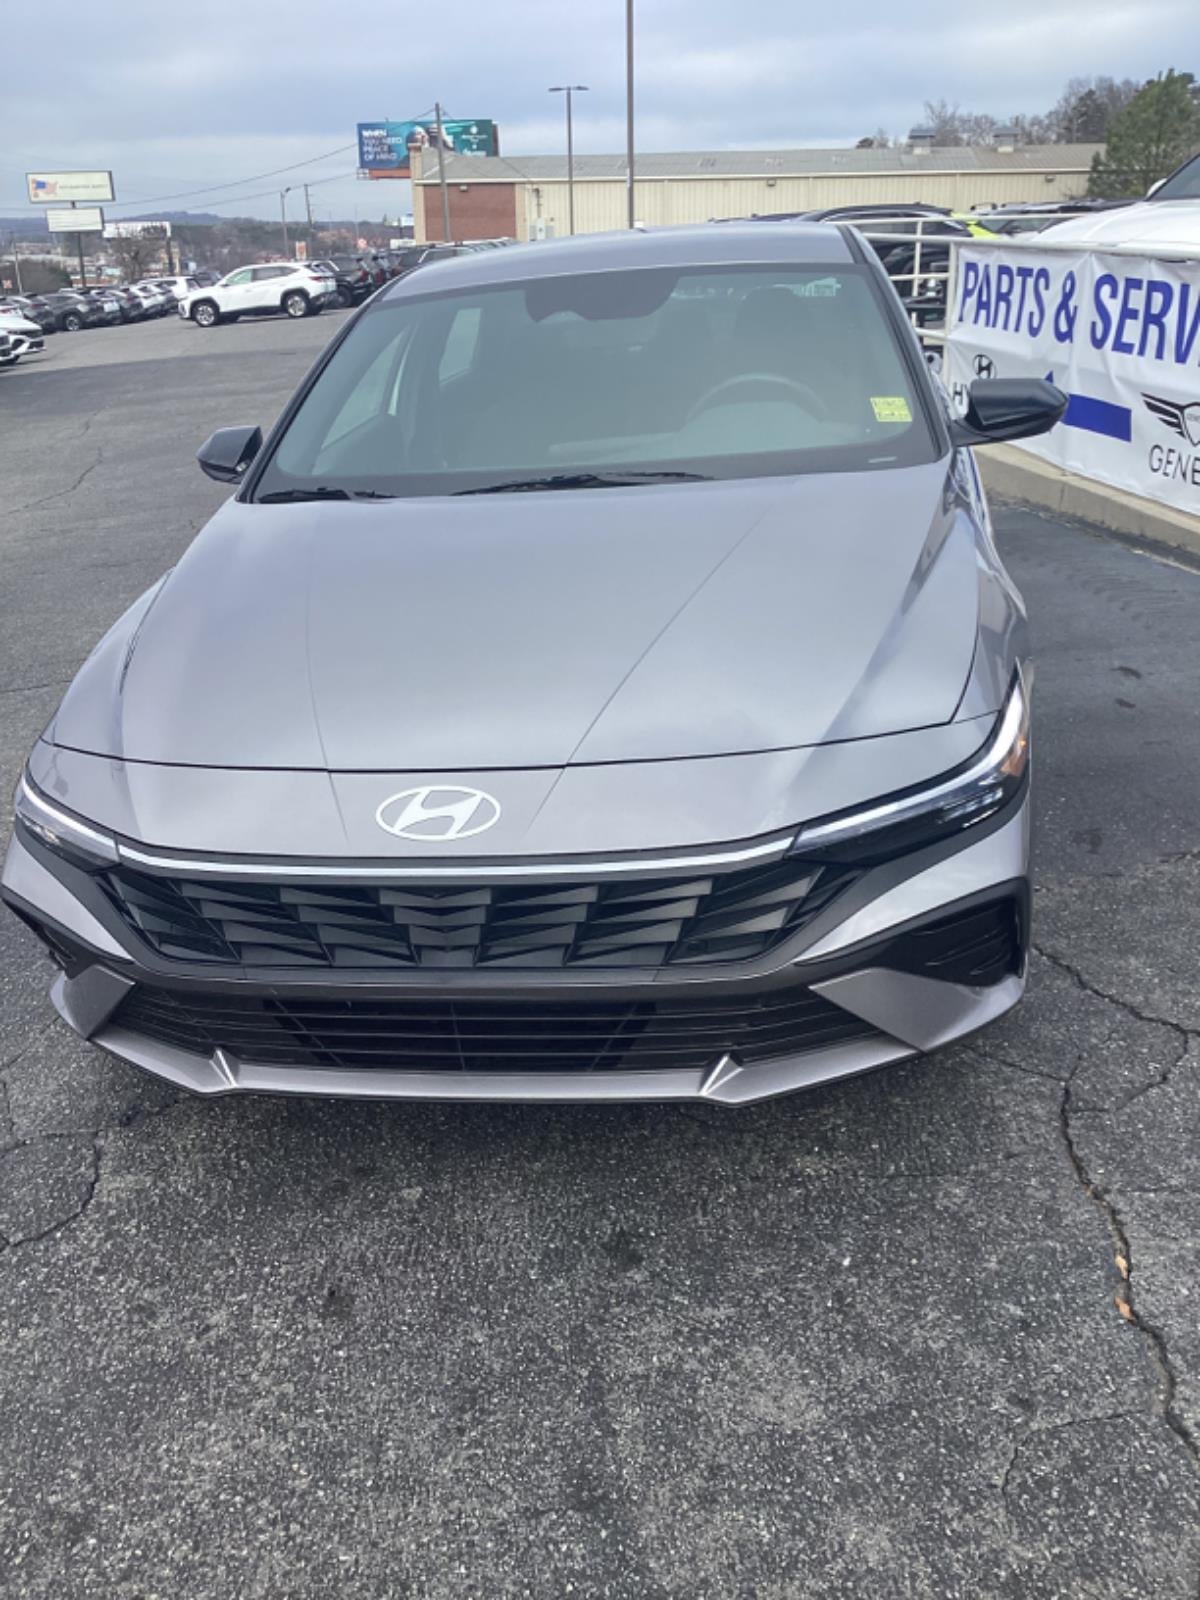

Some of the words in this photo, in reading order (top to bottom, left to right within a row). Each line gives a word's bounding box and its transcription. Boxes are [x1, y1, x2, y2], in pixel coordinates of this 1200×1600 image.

[958, 262, 1050, 338] PARTS
[1054, 270, 1078, 344] &
[1090, 273, 1200, 368] SERV
